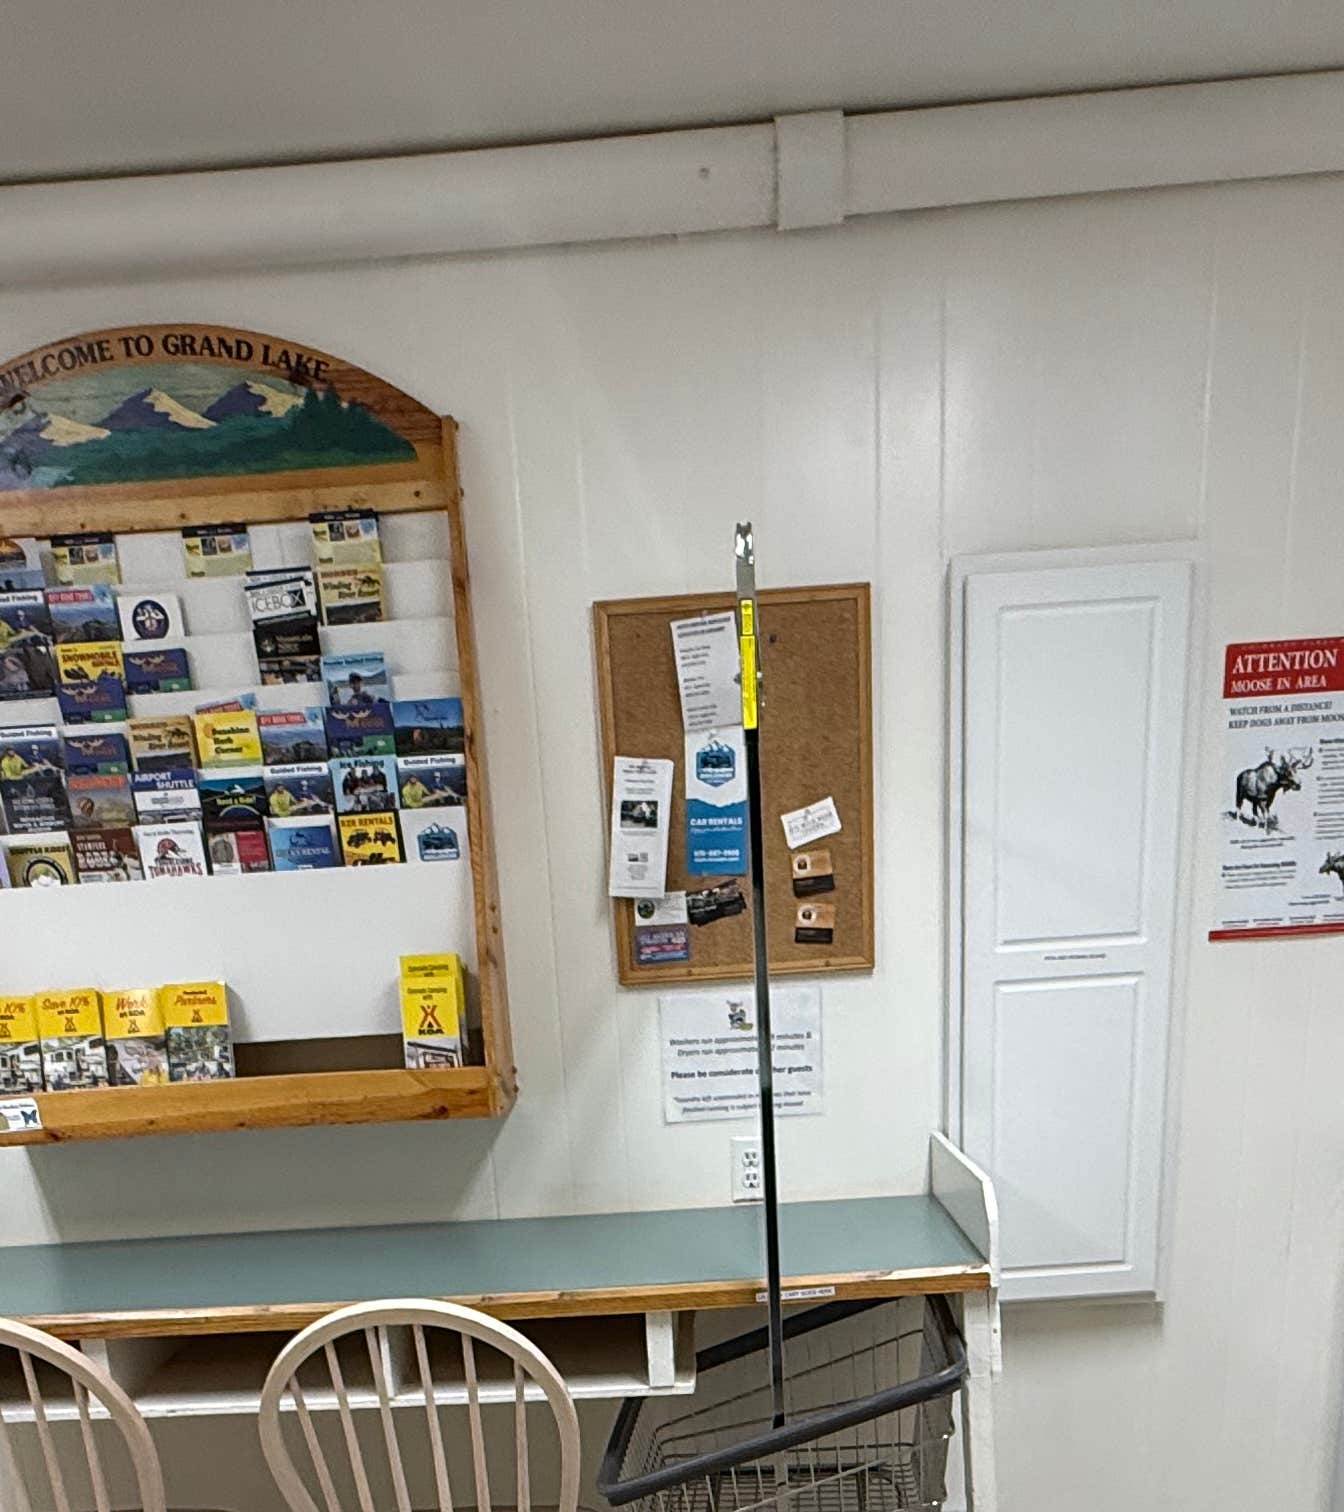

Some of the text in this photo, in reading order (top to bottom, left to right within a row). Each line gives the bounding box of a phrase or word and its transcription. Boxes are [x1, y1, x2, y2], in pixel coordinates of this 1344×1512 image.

[118, 334, 154, 357] TO
[161, 333, 254, 361] GRAND
[262, 343, 331, 382] LAKE
[1232, 649, 1338, 675] ATTENTION
[1230, 675, 1326, 693] MOOSE IN AREA
[1229, 706, 1257, 716] WATCH
[1259, 704, 1282, 714] FROM
[1283, 704, 1289, 713] A
[1228, 719, 1248, 729] KEEP
[1249, 718, 1272, 727] DOGS
[1273, 717, 1296, 726] AWAY
[1297, 715, 1320, 725] FROM
[135, 772, 172, 782] AIRPORT
[156, 780, 194, 789] SHUTTLE
[358, 816, 393, 826] RENTALS
[708, 817, 744, 826] RENTALS
[42, 998, 66, 1010] Save
[418, 1028, 445, 1036] KOA
